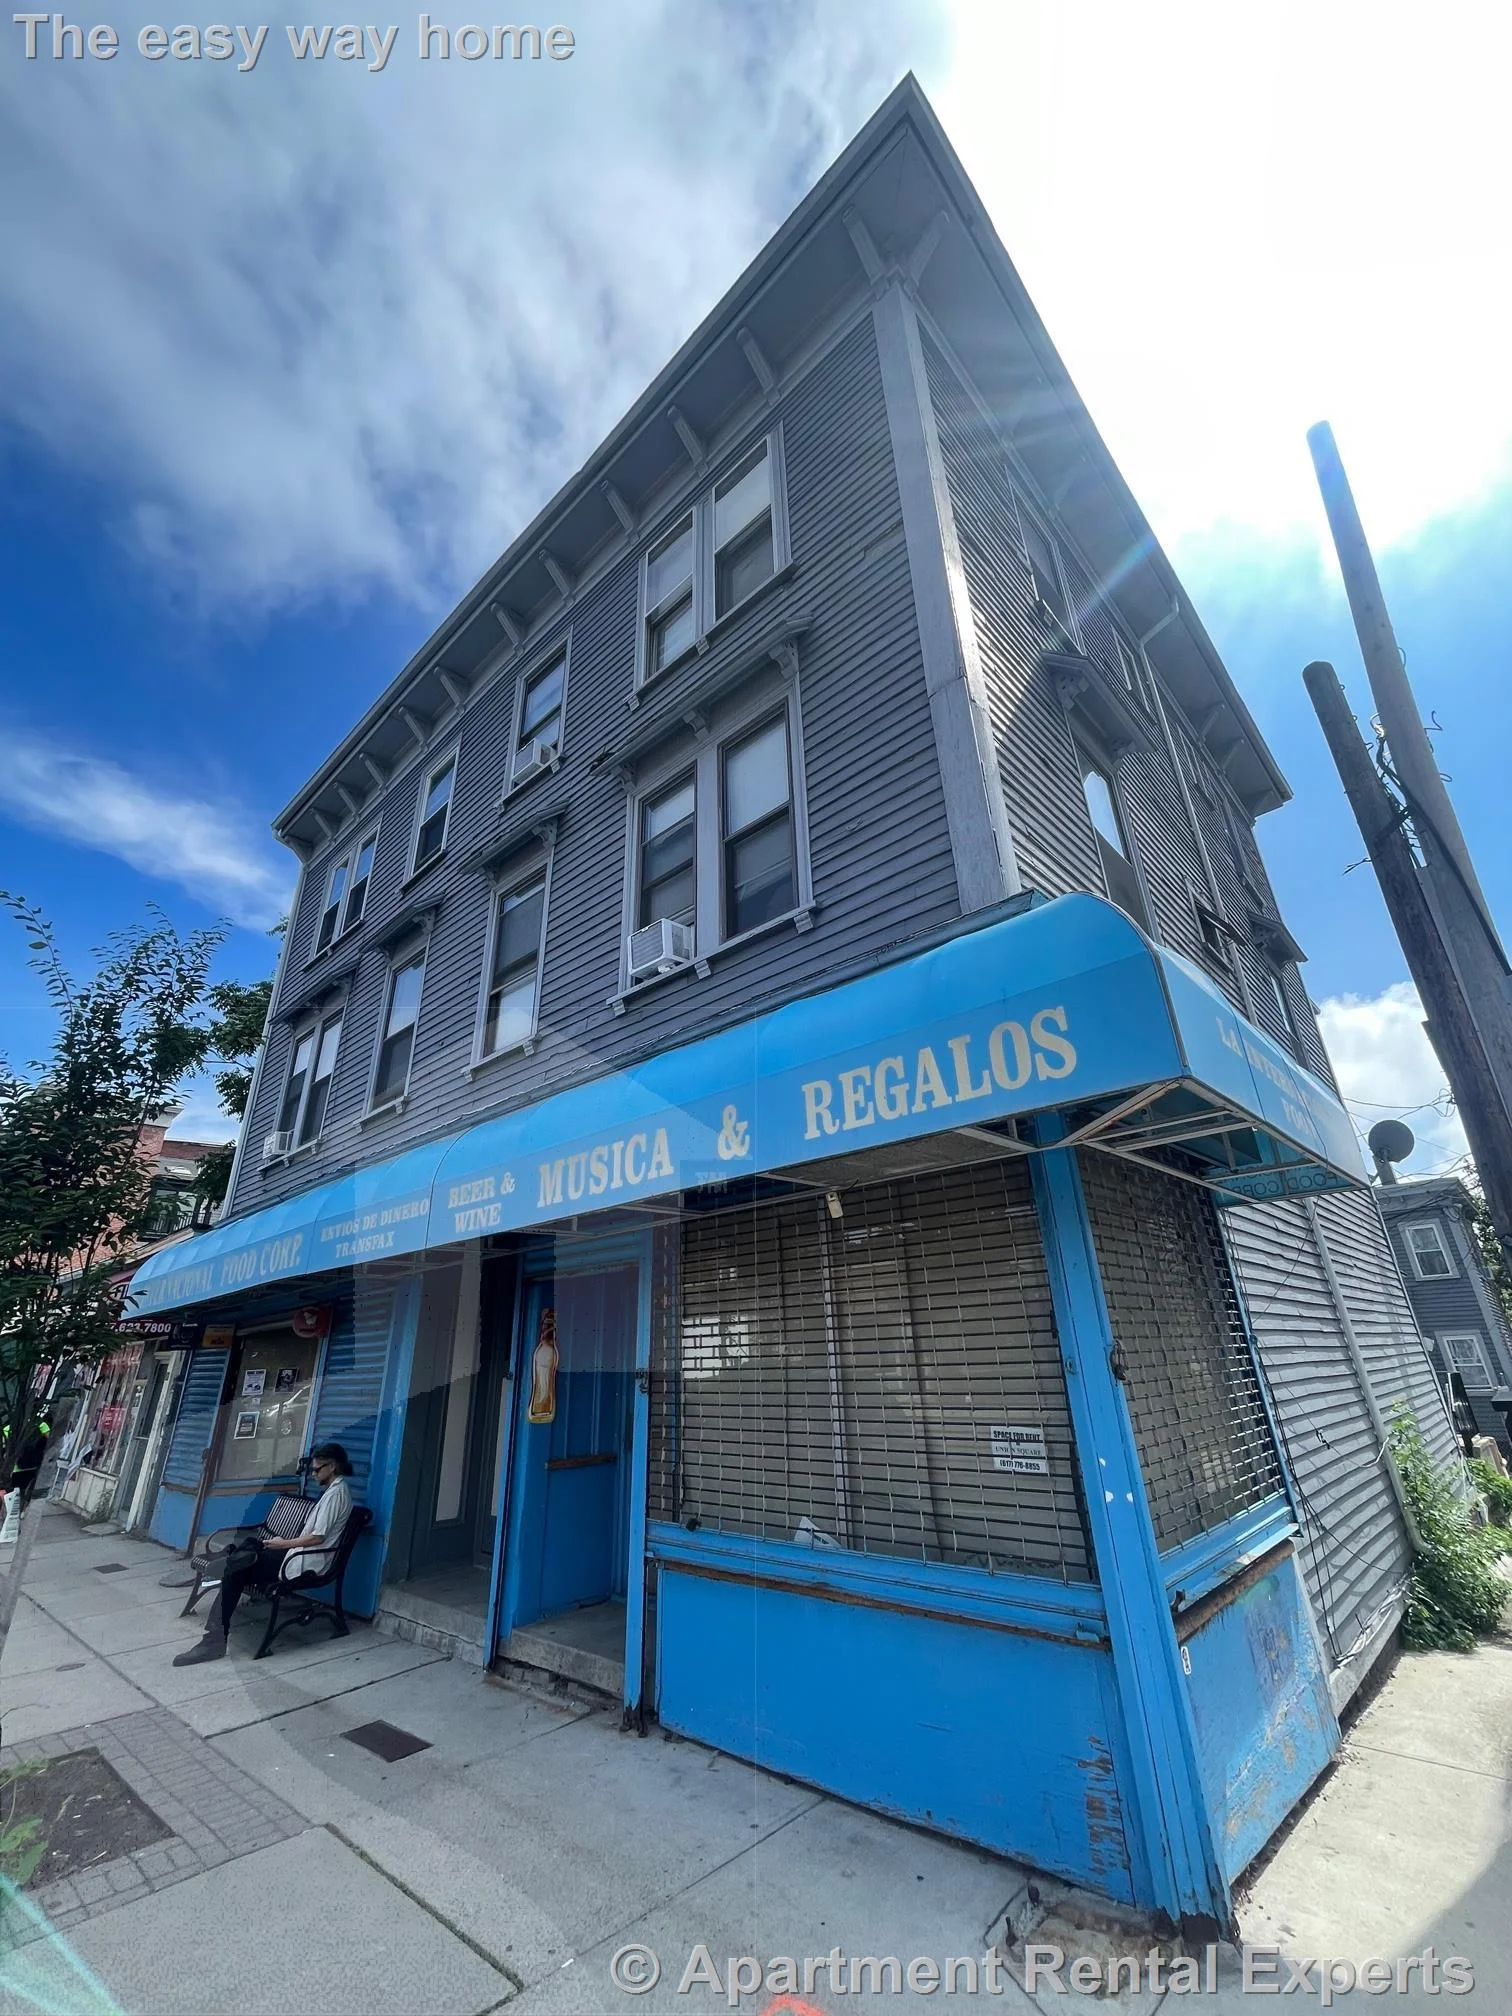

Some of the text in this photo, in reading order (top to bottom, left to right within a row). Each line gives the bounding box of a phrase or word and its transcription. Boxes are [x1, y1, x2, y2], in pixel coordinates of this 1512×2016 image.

[536, 1005, 1078, 1208] MUSICA & REGALOS
[448, 1171, 517, 1209] BEER &
[362, 1212, 379, 1231] DE
[455, 1203, 502, 1234] WINE
